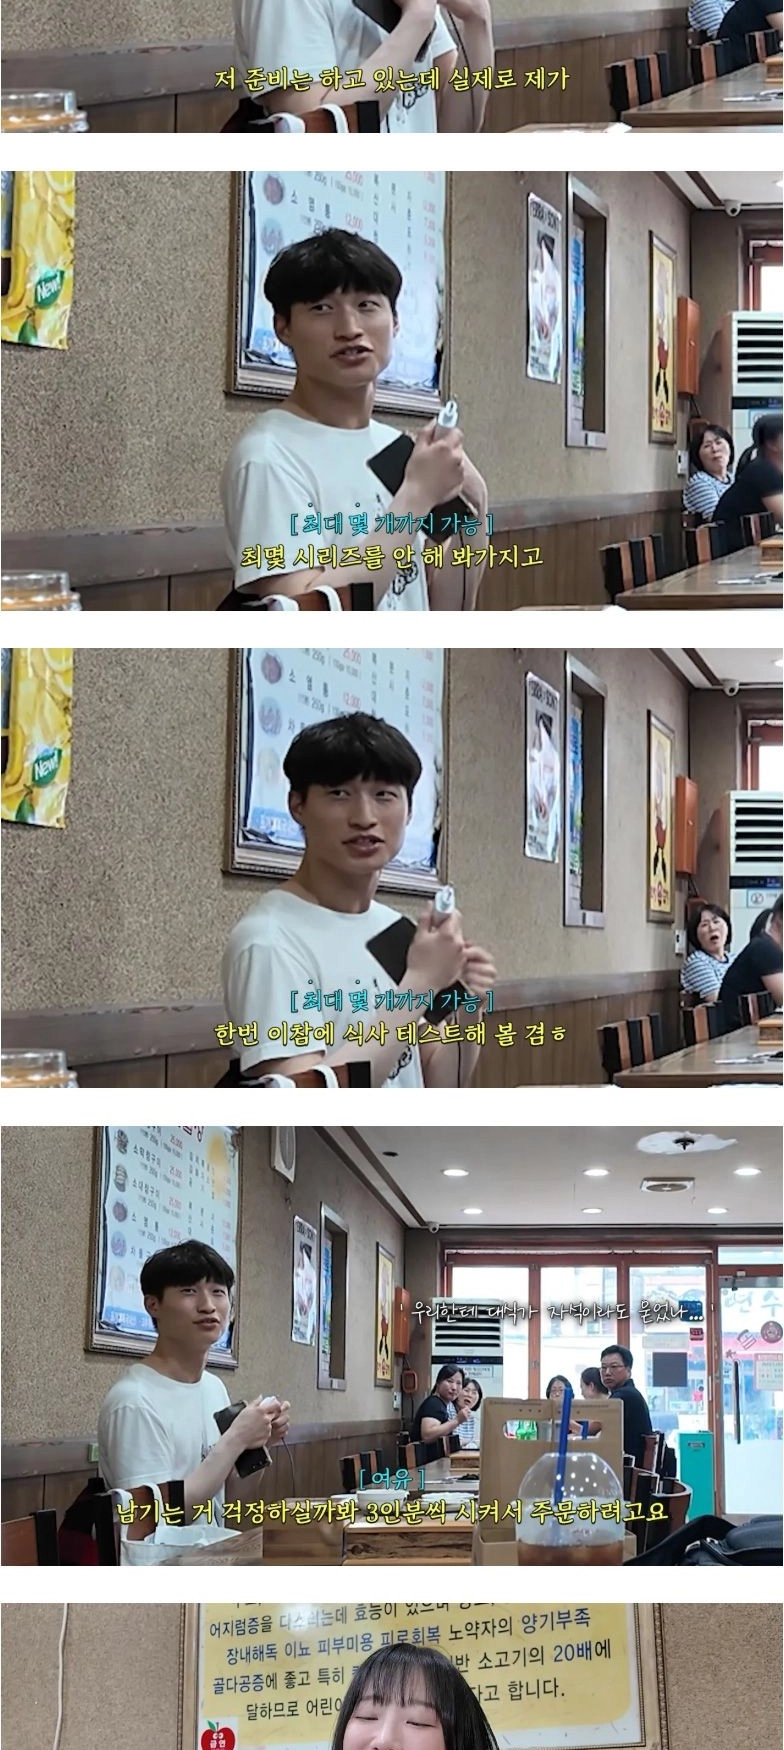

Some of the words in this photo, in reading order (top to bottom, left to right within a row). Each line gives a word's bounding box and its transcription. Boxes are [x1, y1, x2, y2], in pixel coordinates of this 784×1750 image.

[209, 1615, 273, 1638] 어지럼증을
[354, 1603, 398, 1621] 효능이
[226, 1643, 278, 1666] 장내해독
[284, 1641, 311, 1658] 이뇨
[318, 1632, 374, 1656] 피부미용
[381, 1625, 441, 1647] 피로회복
[449, 1616, 513, 1642] 노약자의
[521, 1607, 591, 1636] 양기부족
[213, 1672, 278, 1695] 골다공증에
[284, 1670, 311, 1690] 좋고
[317, 1666, 345, 1685] 특히
[478, 1645, 544, 1672] 소고기의
[553, 1638, 612, 1663] 20배에
[246, 1699, 300, 1721] 달하므로
[507, 1677, 566, 1700] 합니다.
